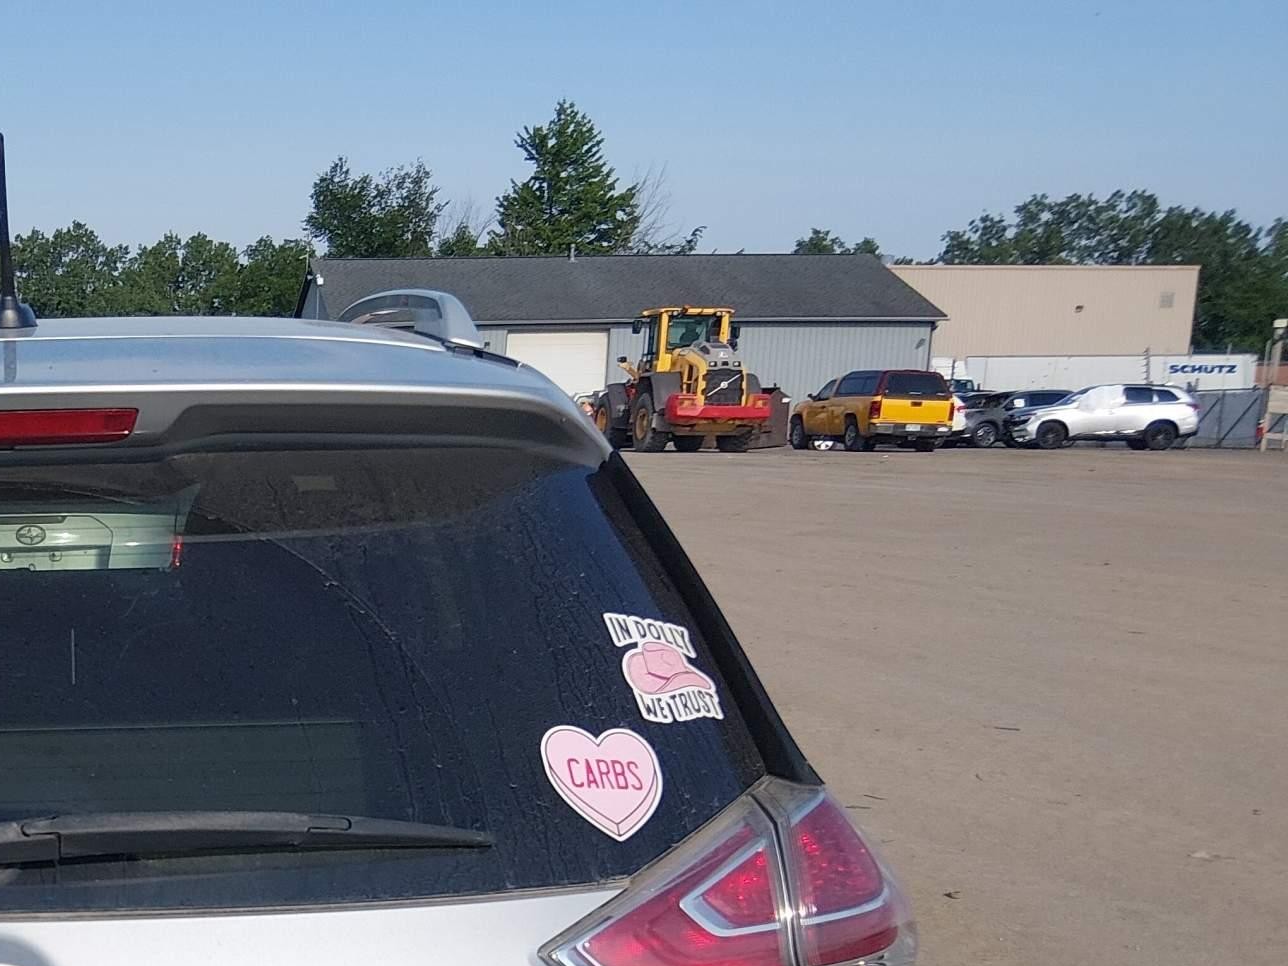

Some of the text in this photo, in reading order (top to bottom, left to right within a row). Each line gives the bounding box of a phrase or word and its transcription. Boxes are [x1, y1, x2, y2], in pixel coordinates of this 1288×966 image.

[608, 616, 692, 655] IN DOLLY
[638, 689, 720, 719] WE TRUST
[567, 758, 643, 791] CARBS
